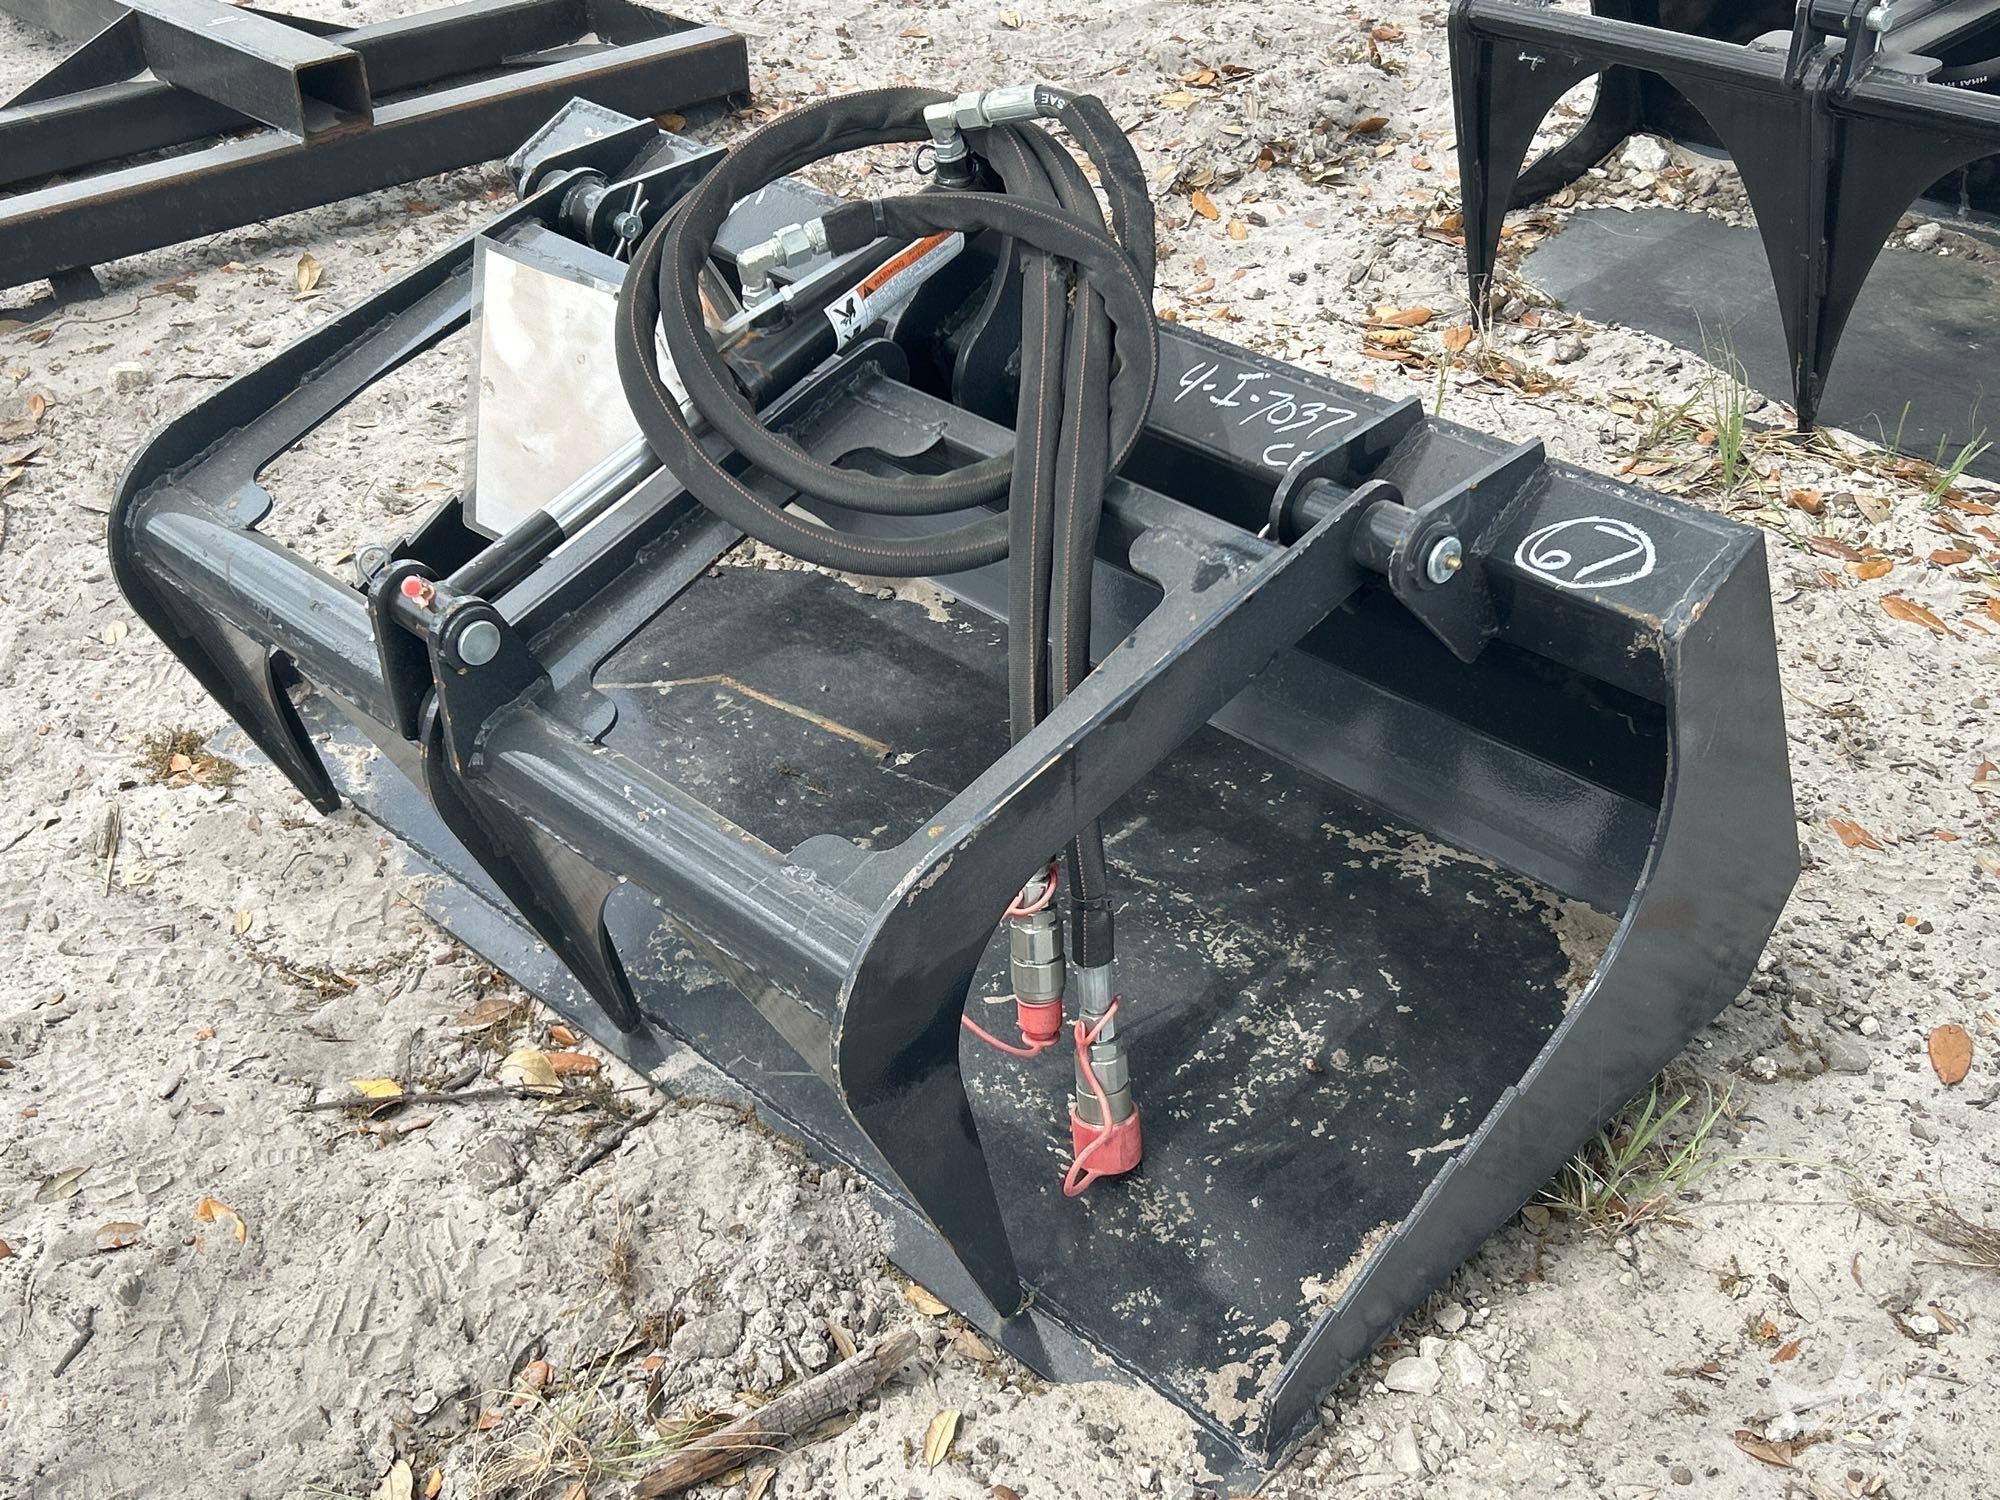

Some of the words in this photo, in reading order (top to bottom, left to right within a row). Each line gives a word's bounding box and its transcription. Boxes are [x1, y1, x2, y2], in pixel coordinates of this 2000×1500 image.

[1041, 93, 1066, 110] SAE
[873, 260, 905, 287] WARNING
[1528, 517, 1643, 581] 67
